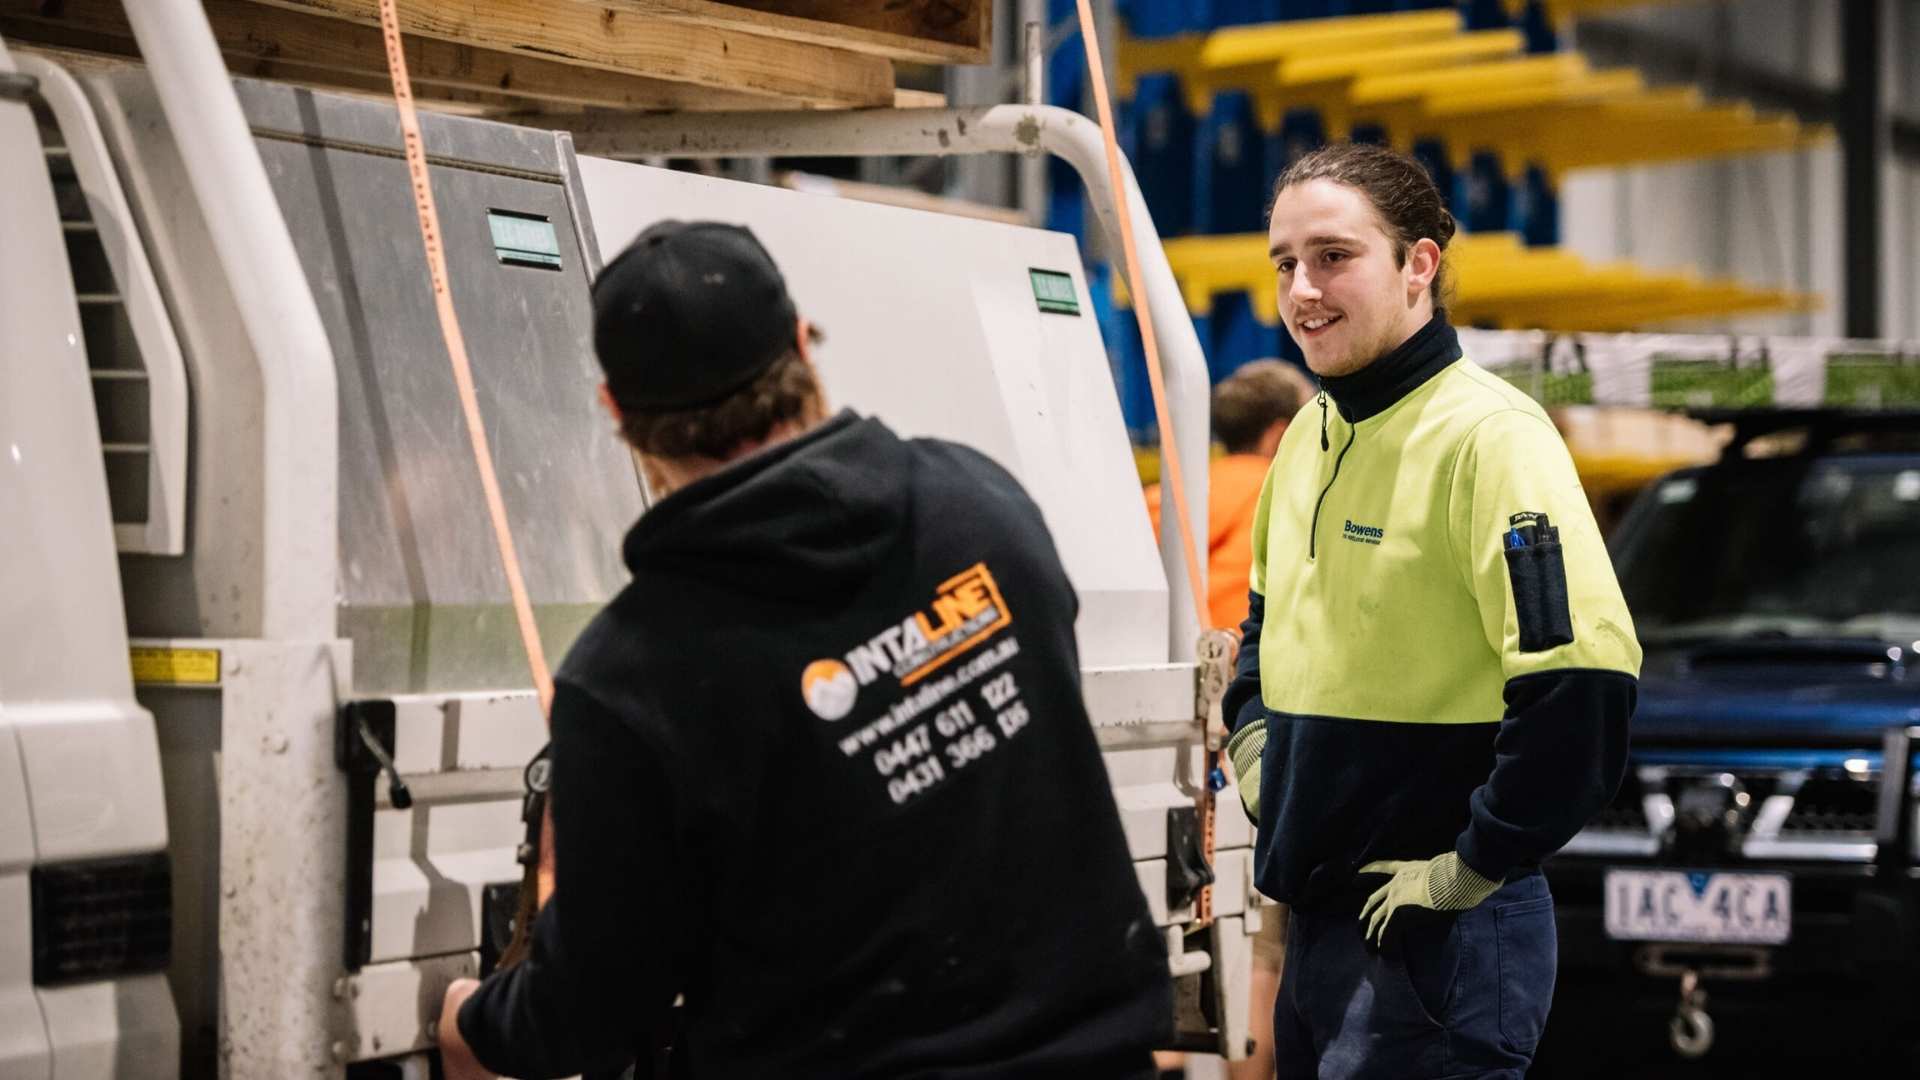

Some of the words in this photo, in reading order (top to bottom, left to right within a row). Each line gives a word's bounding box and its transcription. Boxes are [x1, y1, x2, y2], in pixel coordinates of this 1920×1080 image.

[1344, 519, 1384, 538] Bowens
[845, 575, 994, 686] INTALINE
[838, 636, 1020, 757] www.intaline.com.au
[873, 723, 932, 776] 0447
[934, 699, 976, 737] 611
[887, 755, 945, 804] 0431
[945, 724, 997, 768] 366
